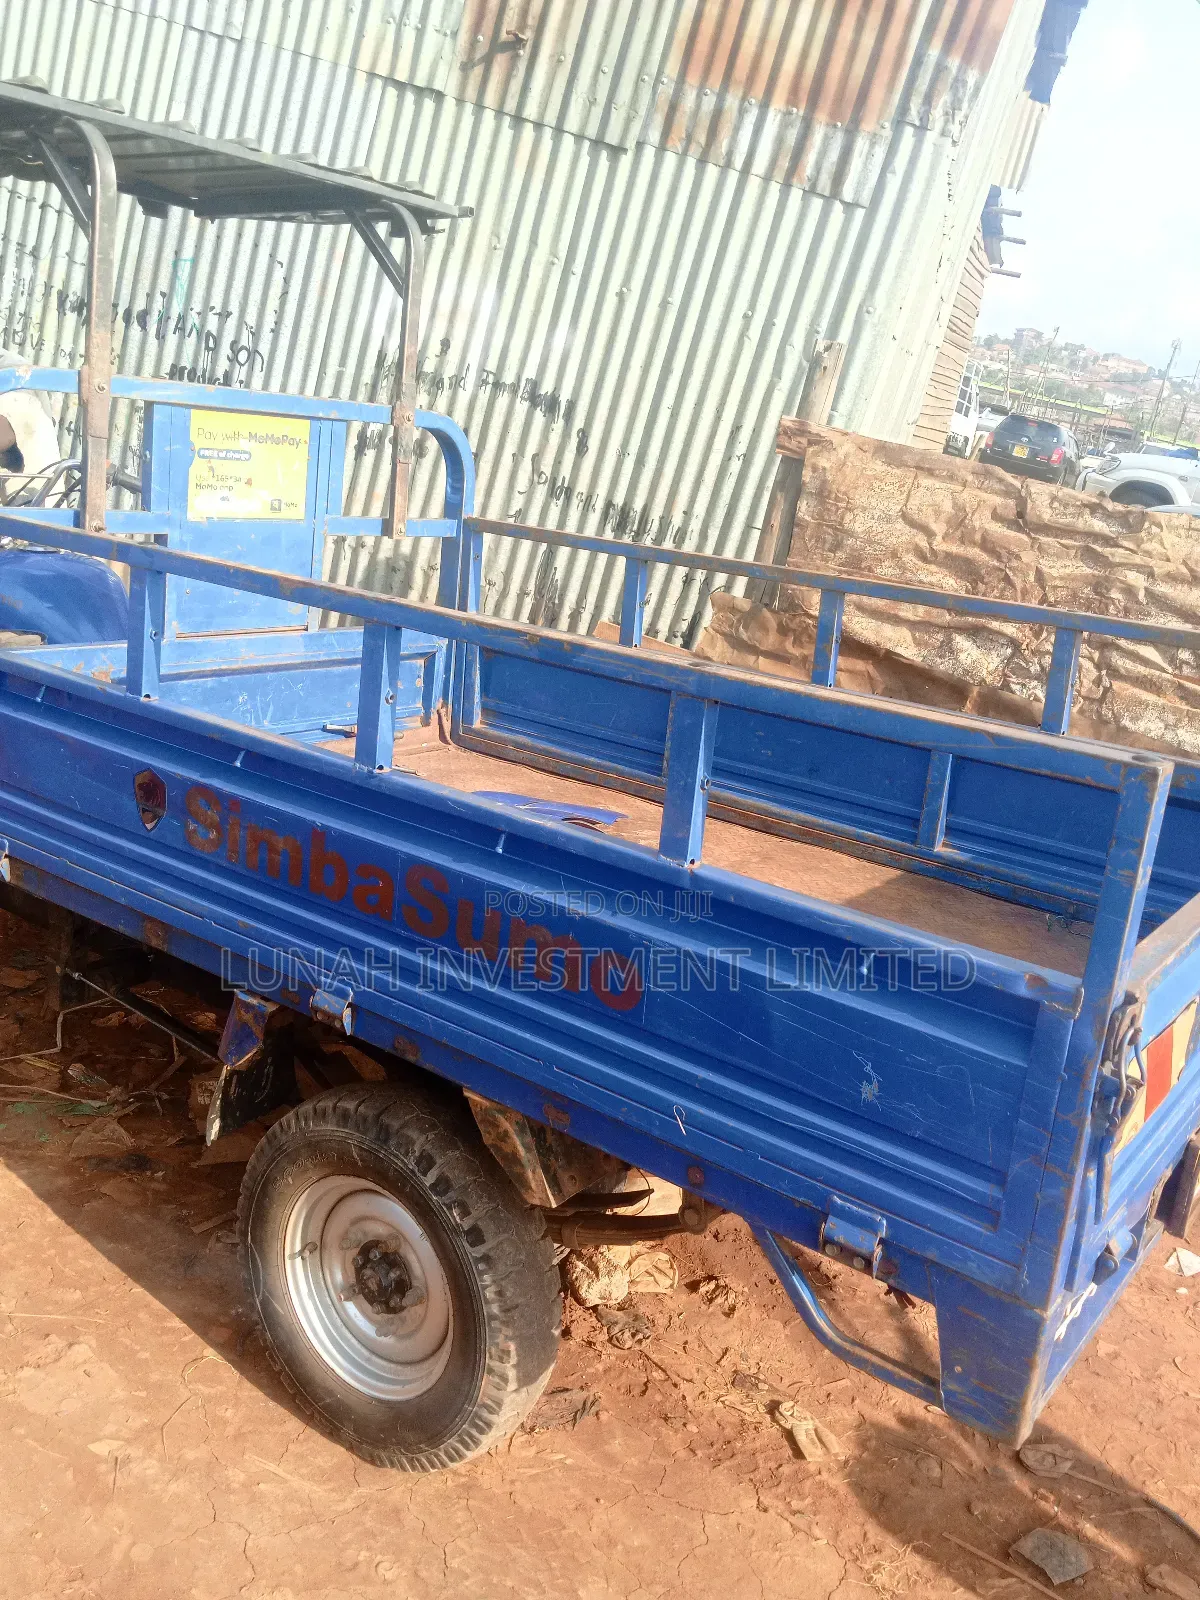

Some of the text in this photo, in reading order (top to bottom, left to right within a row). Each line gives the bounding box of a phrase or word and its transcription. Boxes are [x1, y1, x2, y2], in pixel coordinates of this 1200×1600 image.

[197, 427, 302, 449] Pay with MoMoPay
[199, 448, 219, 458] FREE
[195, 482, 218, 491] MoMo
